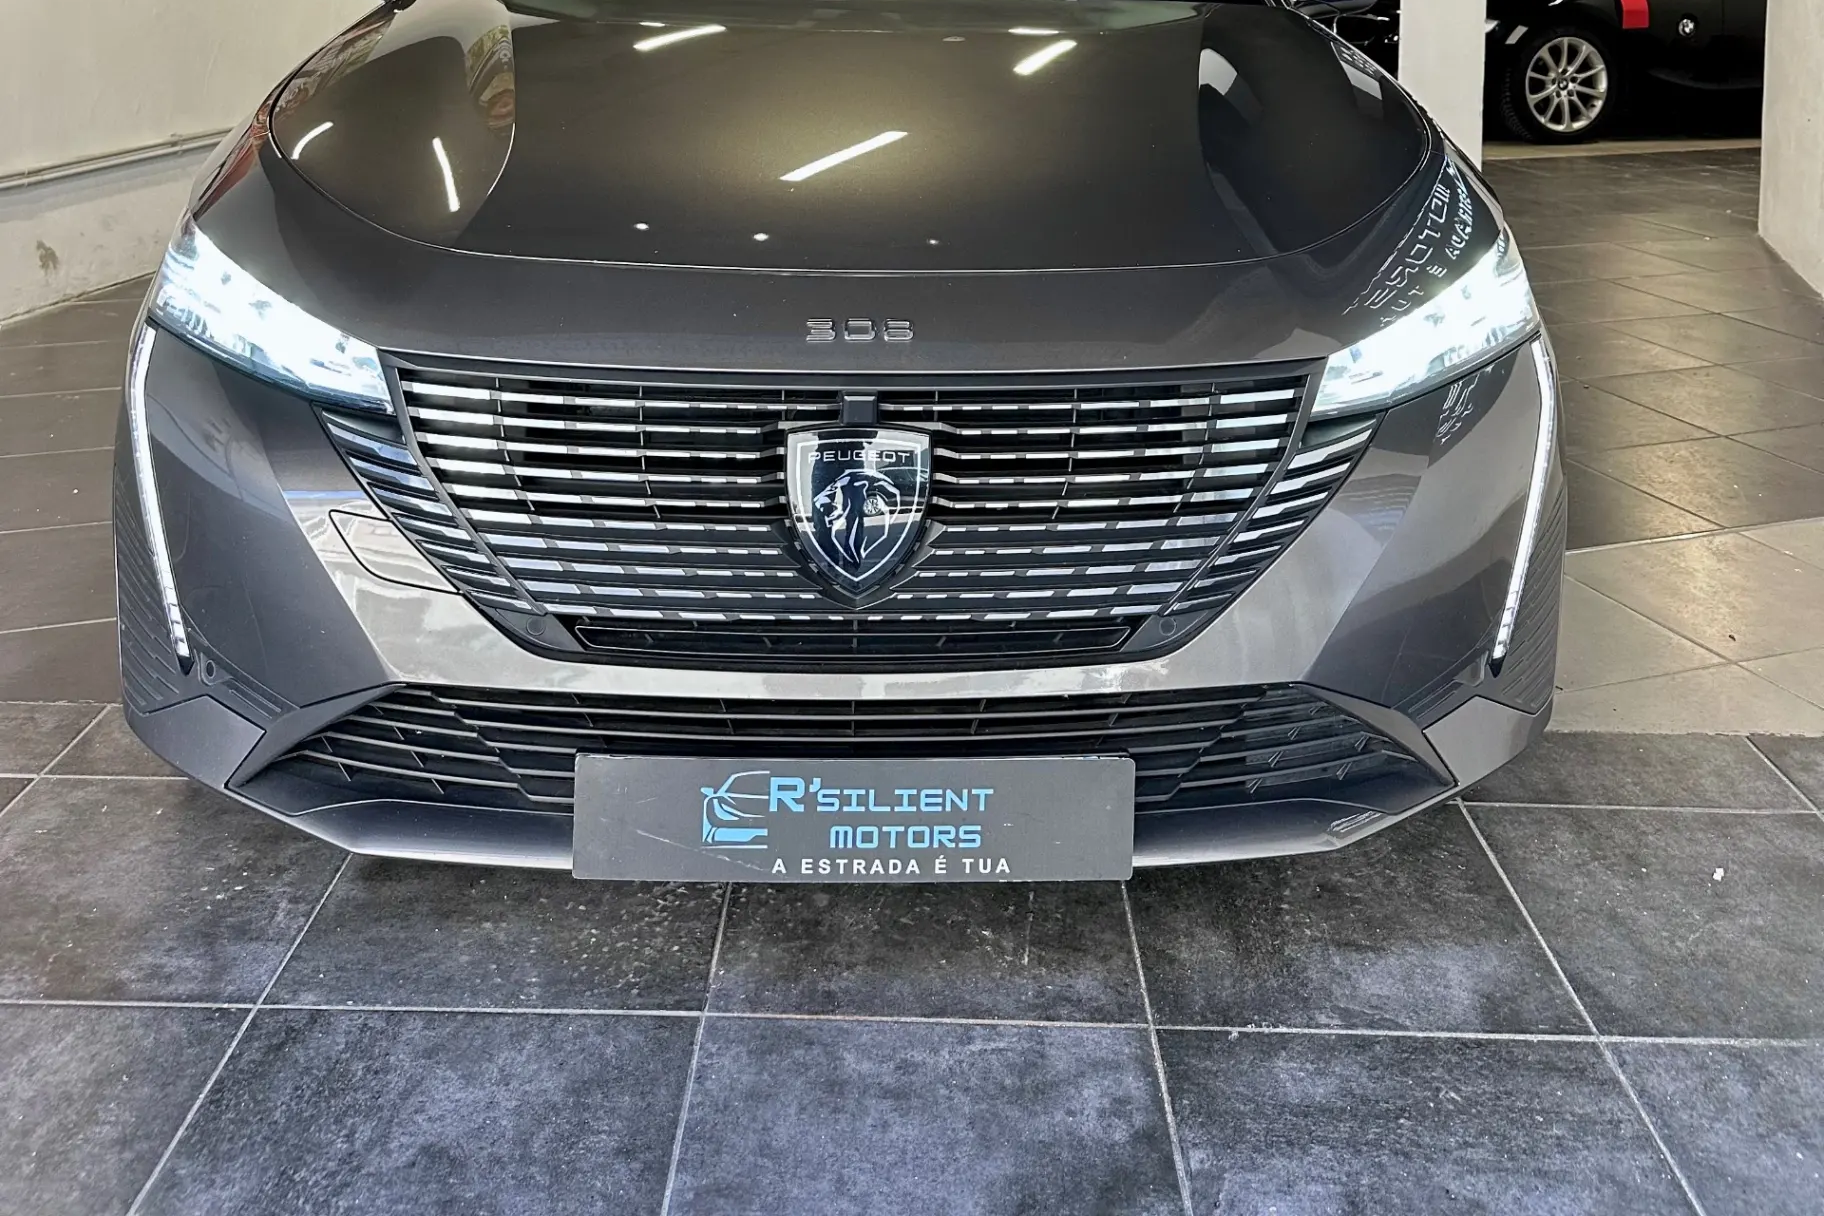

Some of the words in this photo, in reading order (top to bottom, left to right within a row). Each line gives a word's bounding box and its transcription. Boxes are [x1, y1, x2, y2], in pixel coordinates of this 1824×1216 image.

[805, 317, 915, 343] 308
[808, 450, 910, 464] PEUGEOT
[769, 777, 994, 812] R'SILIENT
[829, 825, 982, 849] MOTORS
[771, 858, 787, 874] A
[801, 858, 921, 875] ESTRADA
[934, 854, 947, 875] É
[962, 858, 1011, 874] TUA
